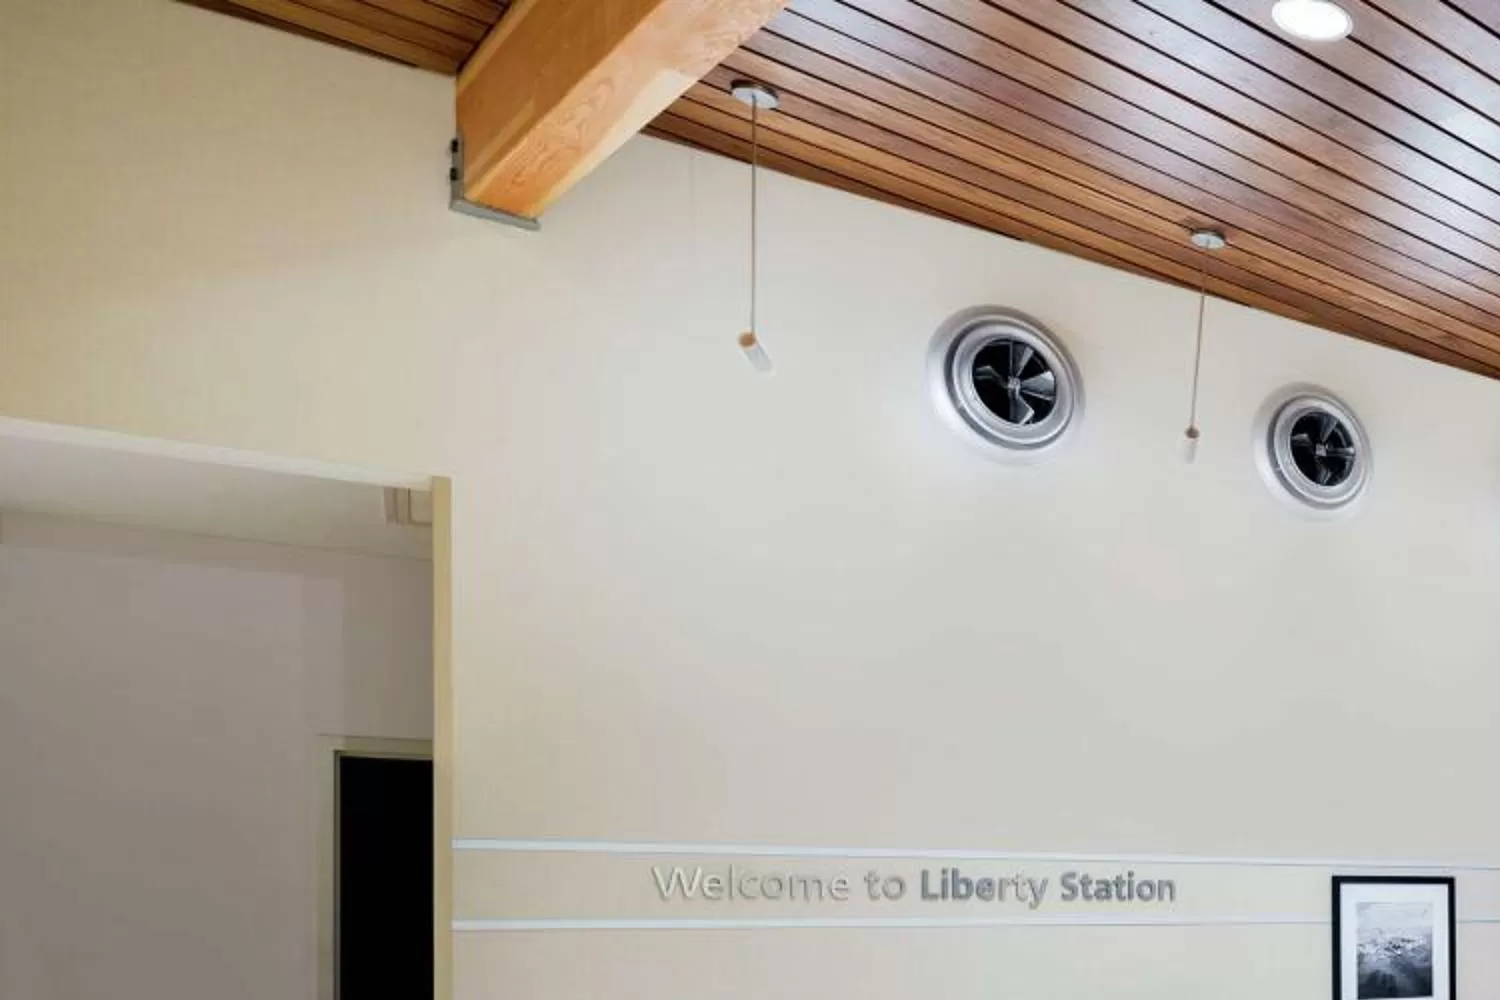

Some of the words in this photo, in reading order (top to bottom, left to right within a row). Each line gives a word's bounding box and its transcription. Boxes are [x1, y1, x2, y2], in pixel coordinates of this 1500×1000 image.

[651, 863, 849, 902] Welcome
[863, 869, 907, 901] to
[920, 867, 1049, 910] Liberty
[1060, 870, 1176, 903] Station
